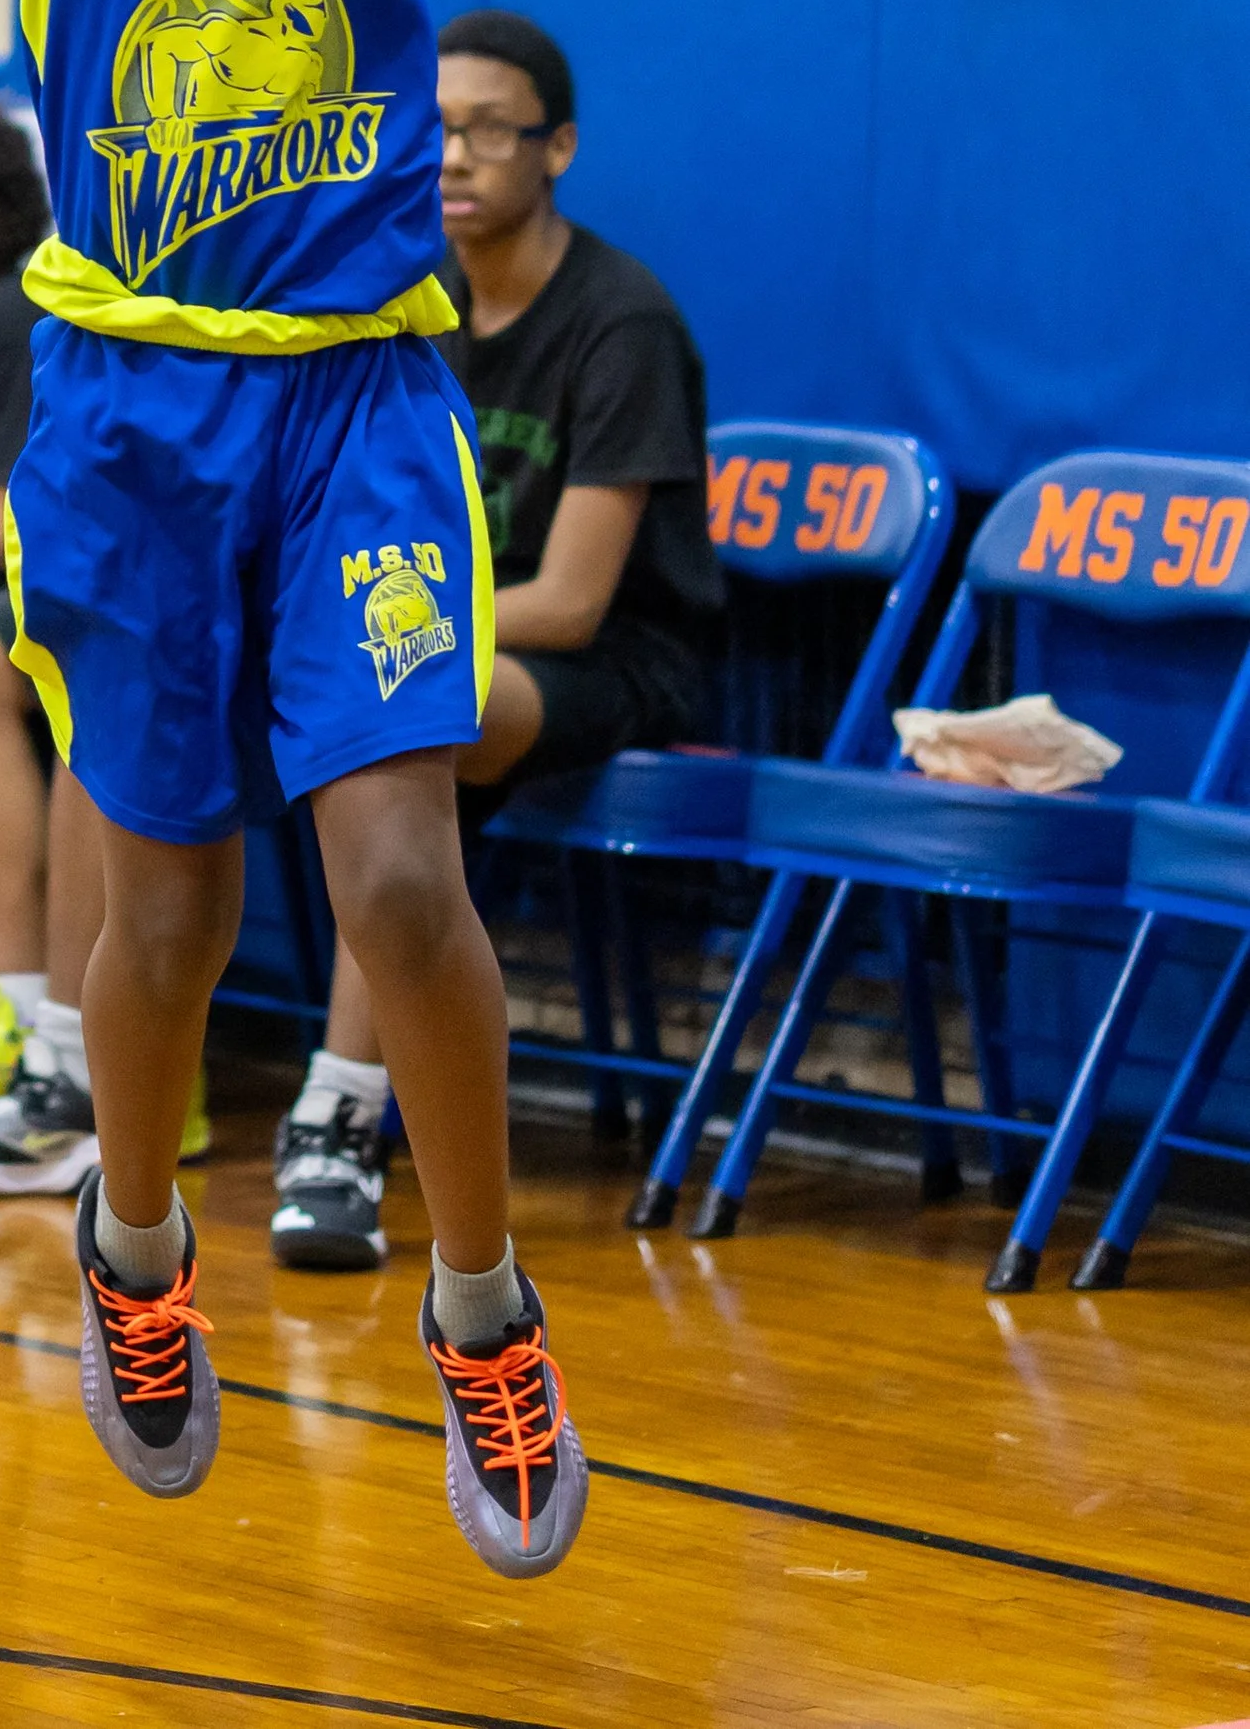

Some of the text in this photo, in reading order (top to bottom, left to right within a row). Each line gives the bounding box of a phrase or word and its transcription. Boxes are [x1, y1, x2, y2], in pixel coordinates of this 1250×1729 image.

[116, 106, 380, 283] WARRIORS
[707, 455, 889, 553] MS 50
[1018, 483, 1249, 589] MS 50
[340, 544, 412, 599] M.S.
[377, 623, 456, 695] WARRIORS
